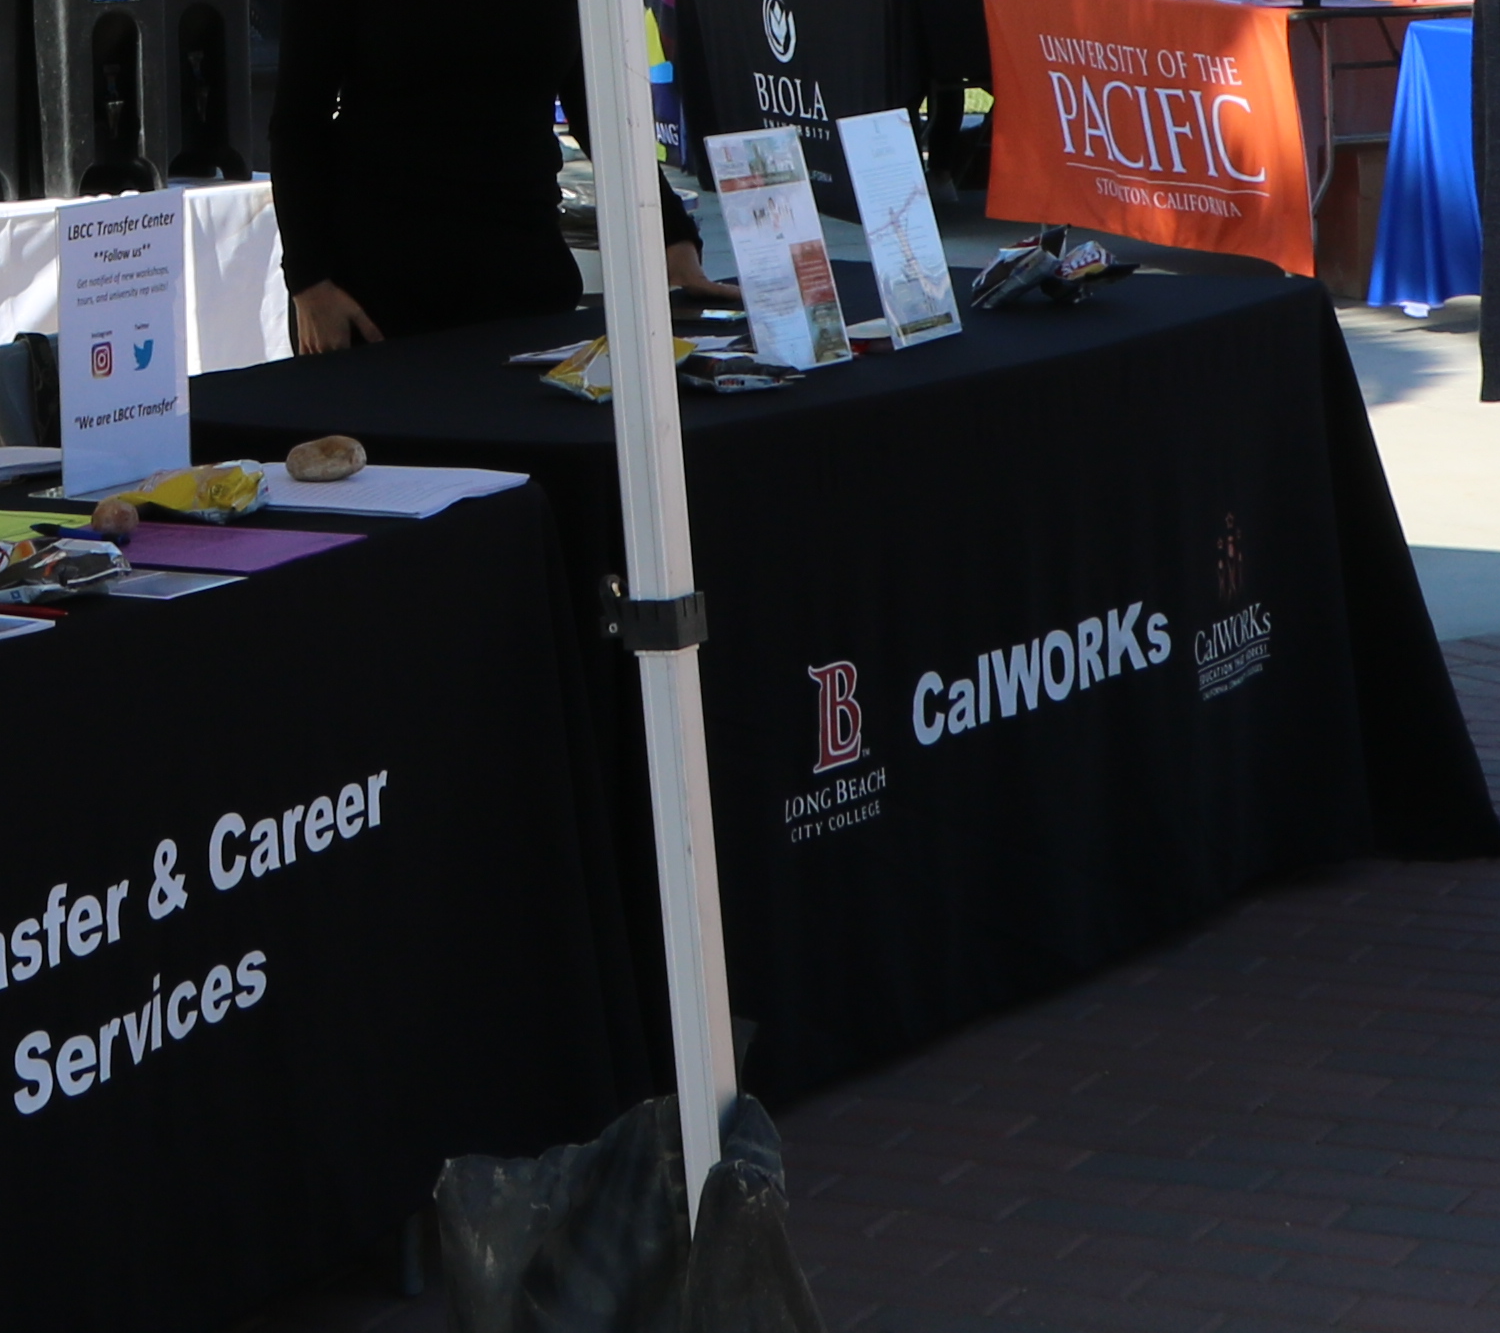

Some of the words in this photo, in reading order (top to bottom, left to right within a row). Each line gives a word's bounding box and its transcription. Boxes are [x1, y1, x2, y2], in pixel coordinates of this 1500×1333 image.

[1039, 34, 1148, 76] UNIVERSITY
[1157, 49, 1187, 78] OF
[1194, 53, 1242, 86] THE
[753, 72, 828, 121] BIOLA
[1048, 70, 1266, 183] PACIFIC
[68, 222, 93, 241] LBCC
[97, 216, 139, 238] Transfer
[141, 212, 174, 230] Center
[1153, 191, 1242, 218] CALIFORNIA
[96, 413, 111, 426] are
[113, 405, 135, 423] LBCC
[1195, 603, 1271, 665] CalWORKs
[912, 601, 1171, 746] CalWORKs
[784, 779, 832, 825] LONG
[835, 767, 887, 804] BEACH
[790, 821, 823, 843] CITY
[828, 799, 881, 830] COLLEGE
[147, 838, 189, 921] &
[208, 769, 389, 891] Career
[12, 949, 268, 1116] Services
